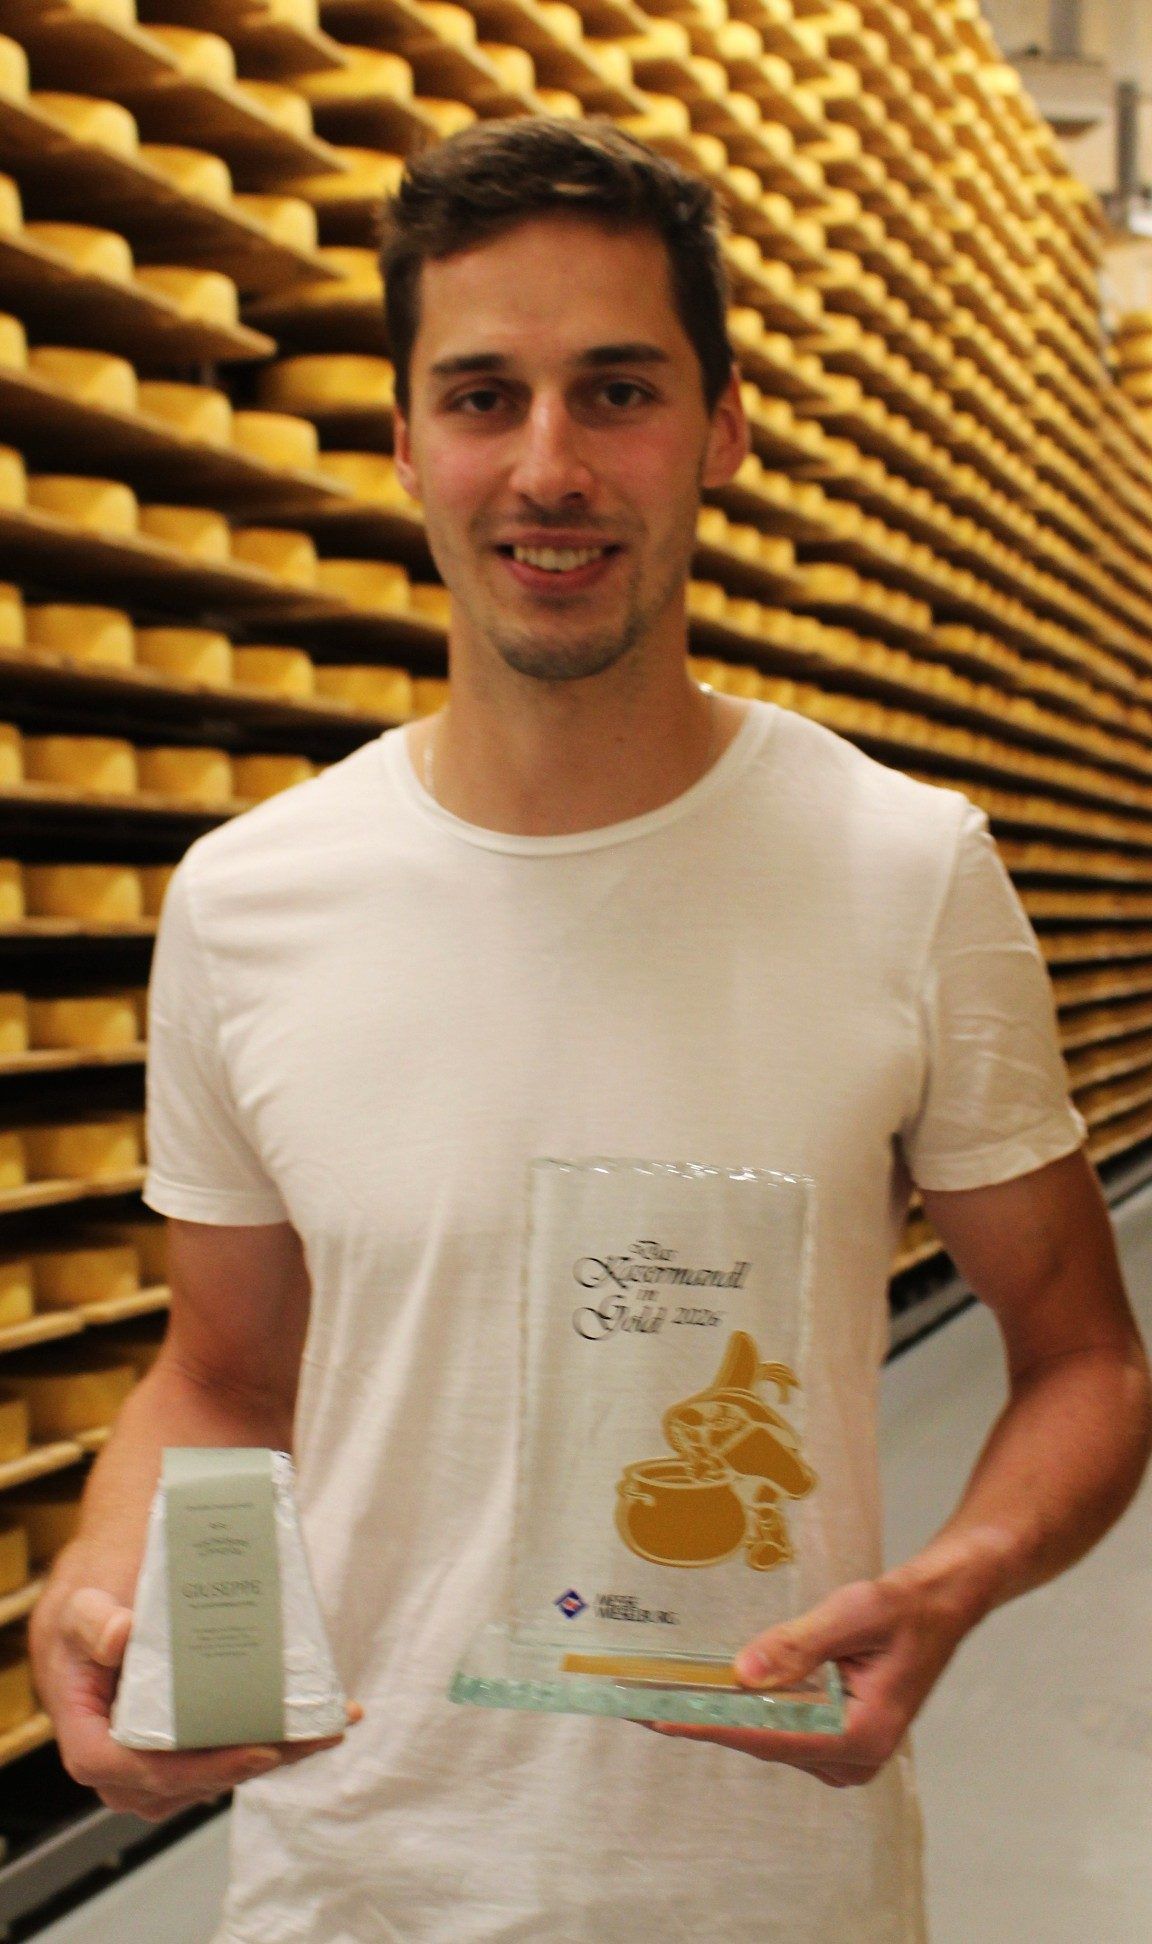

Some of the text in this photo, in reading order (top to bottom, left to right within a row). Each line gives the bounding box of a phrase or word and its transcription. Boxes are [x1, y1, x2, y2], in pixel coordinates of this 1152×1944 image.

[627, 1240, 679, 1262] Das
[636, 1288, 660, 1301] in
[572, 1294, 669, 1341] Gold
